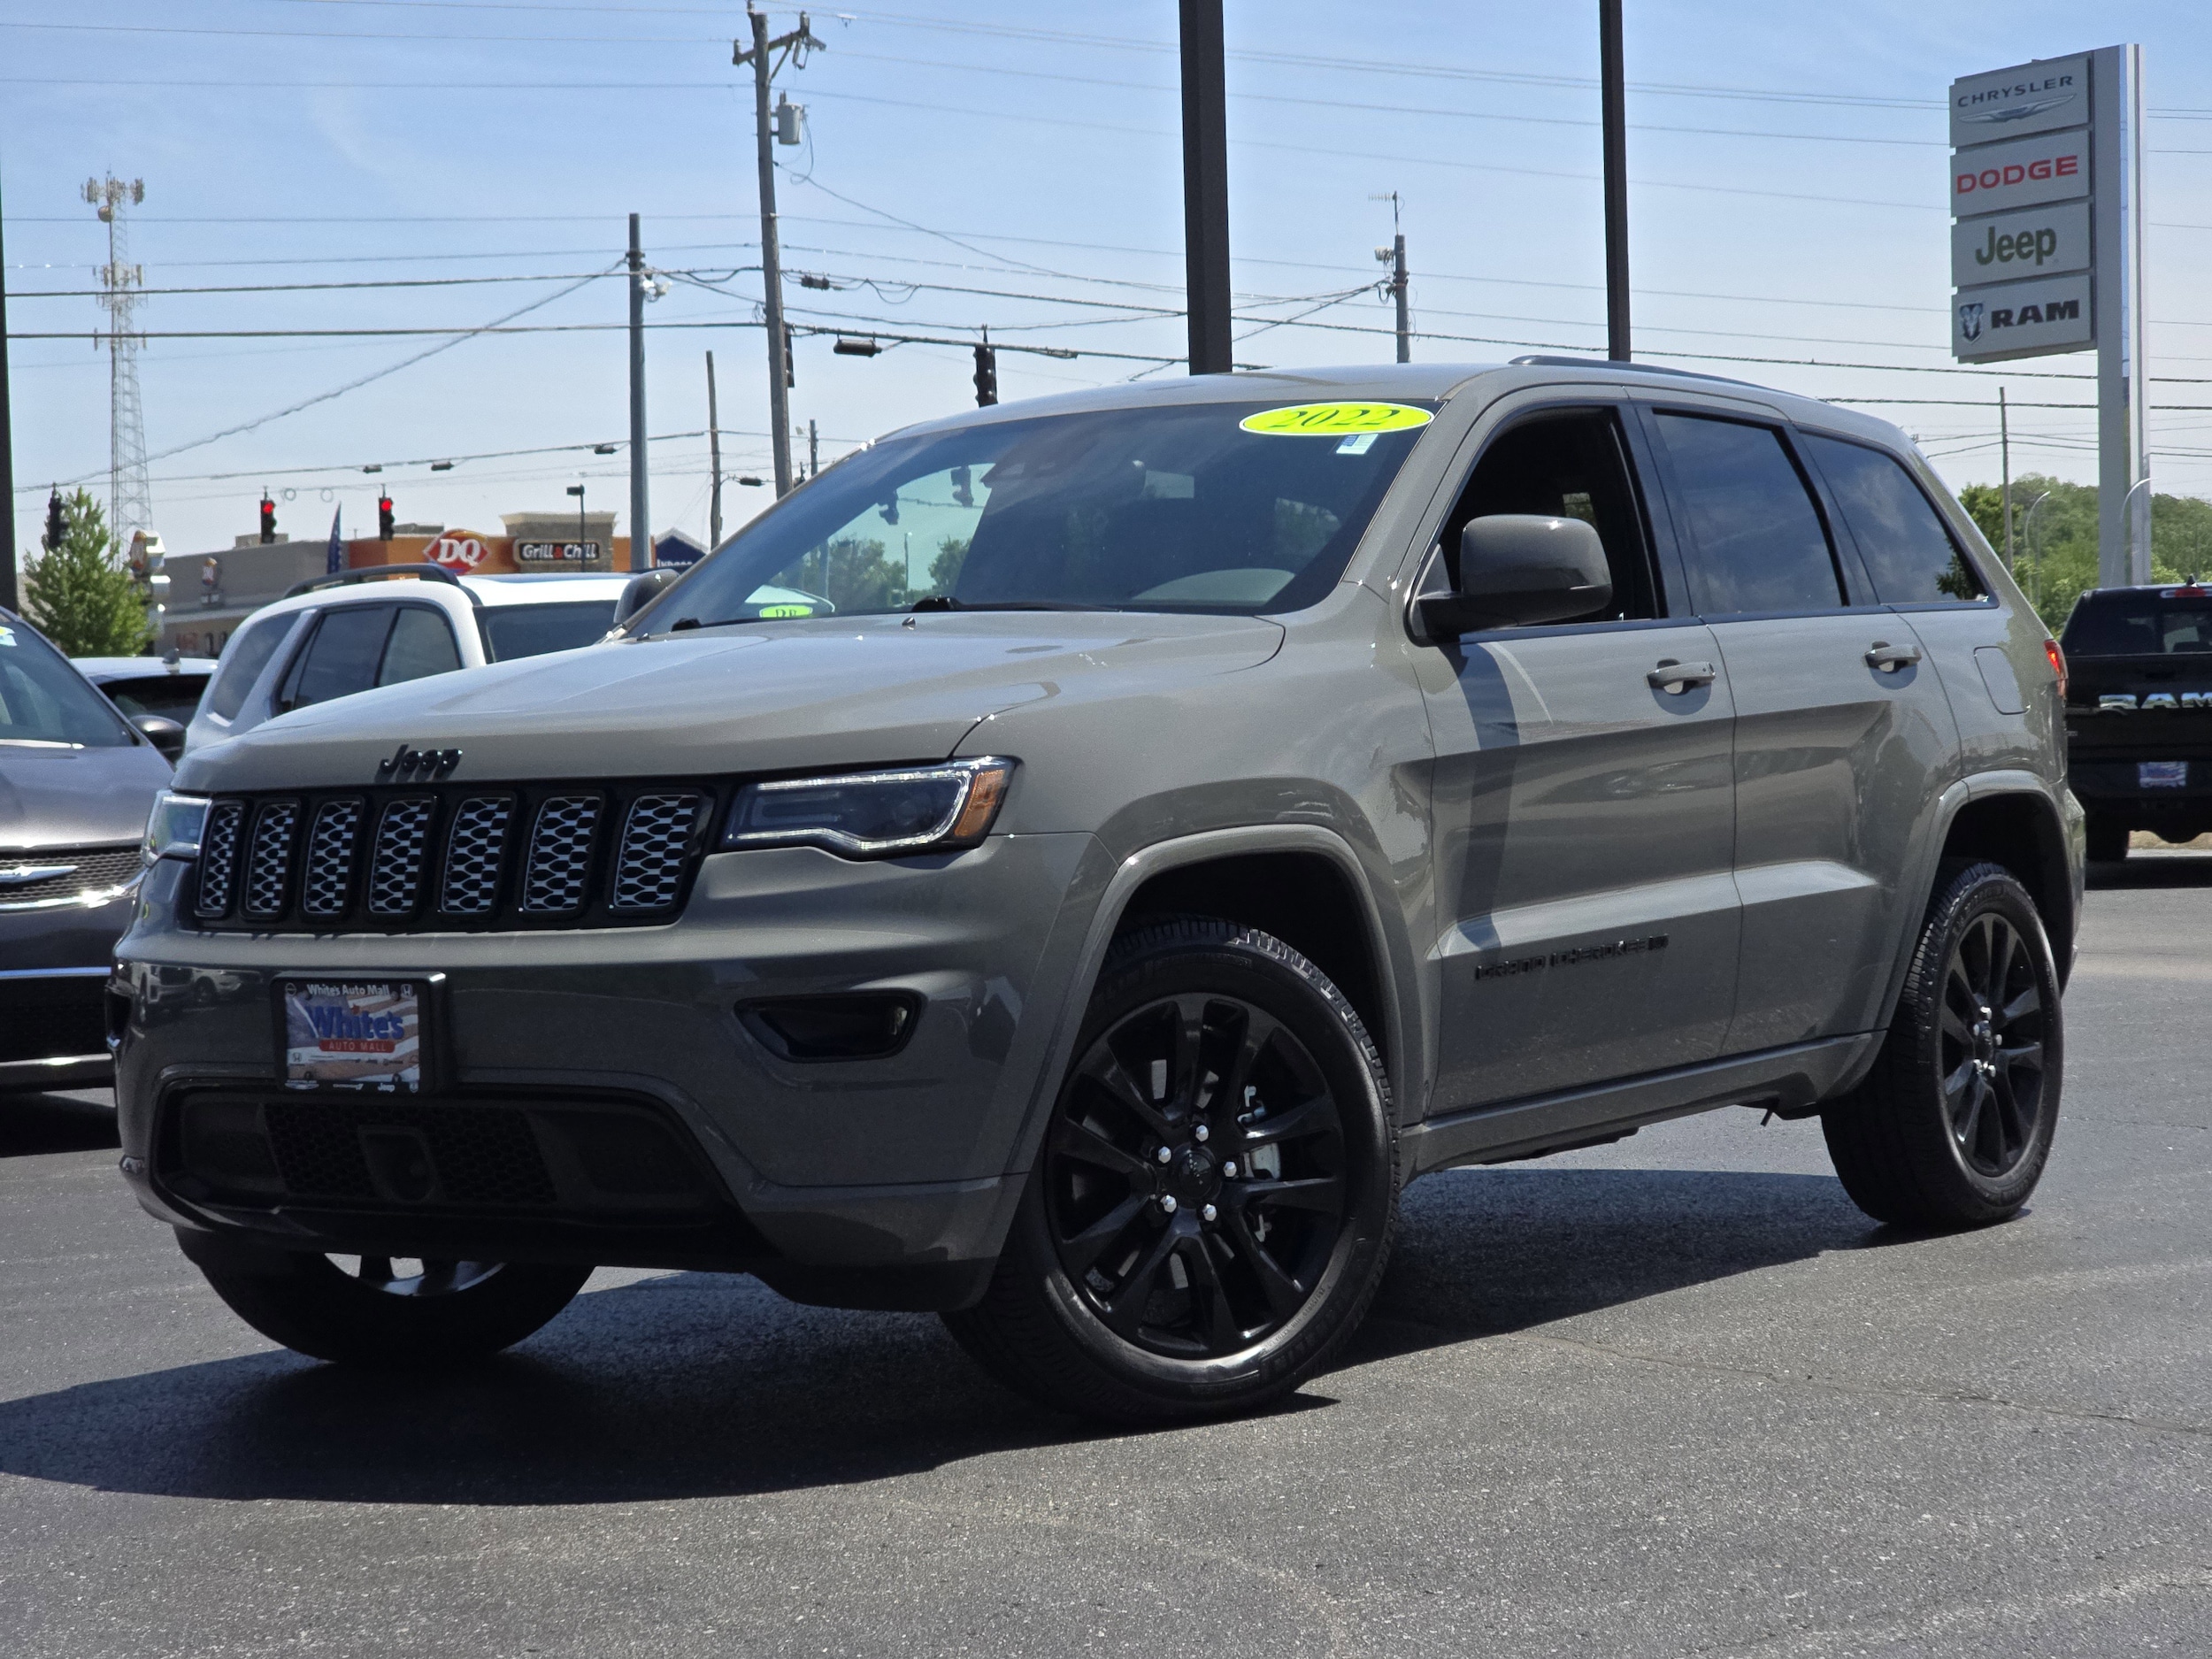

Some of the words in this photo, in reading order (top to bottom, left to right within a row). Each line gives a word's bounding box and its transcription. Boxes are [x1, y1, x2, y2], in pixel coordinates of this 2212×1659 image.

[1957, 75, 2074, 108] CHRYSLER
[1956, 155, 2078, 195] DODGE
[1975, 226, 2057, 265] Jeep
[1991, 299, 2079, 330] RAM
[1268, 409, 1401, 428] 2022
[437, 538, 480, 565] DQ
[2099, 692, 2212, 710] RAM
[375, 744, 463, 781] Jeep
[307, 984, 341, 996] White's
[342, 984, 365, 995] Auto
[366, 984, 391, 996] Mall
[304, 1005, 405, 1040] White's
[328, 1041, 355, 1051] AUTO
[360, 1042, 387, 1052] MALL
